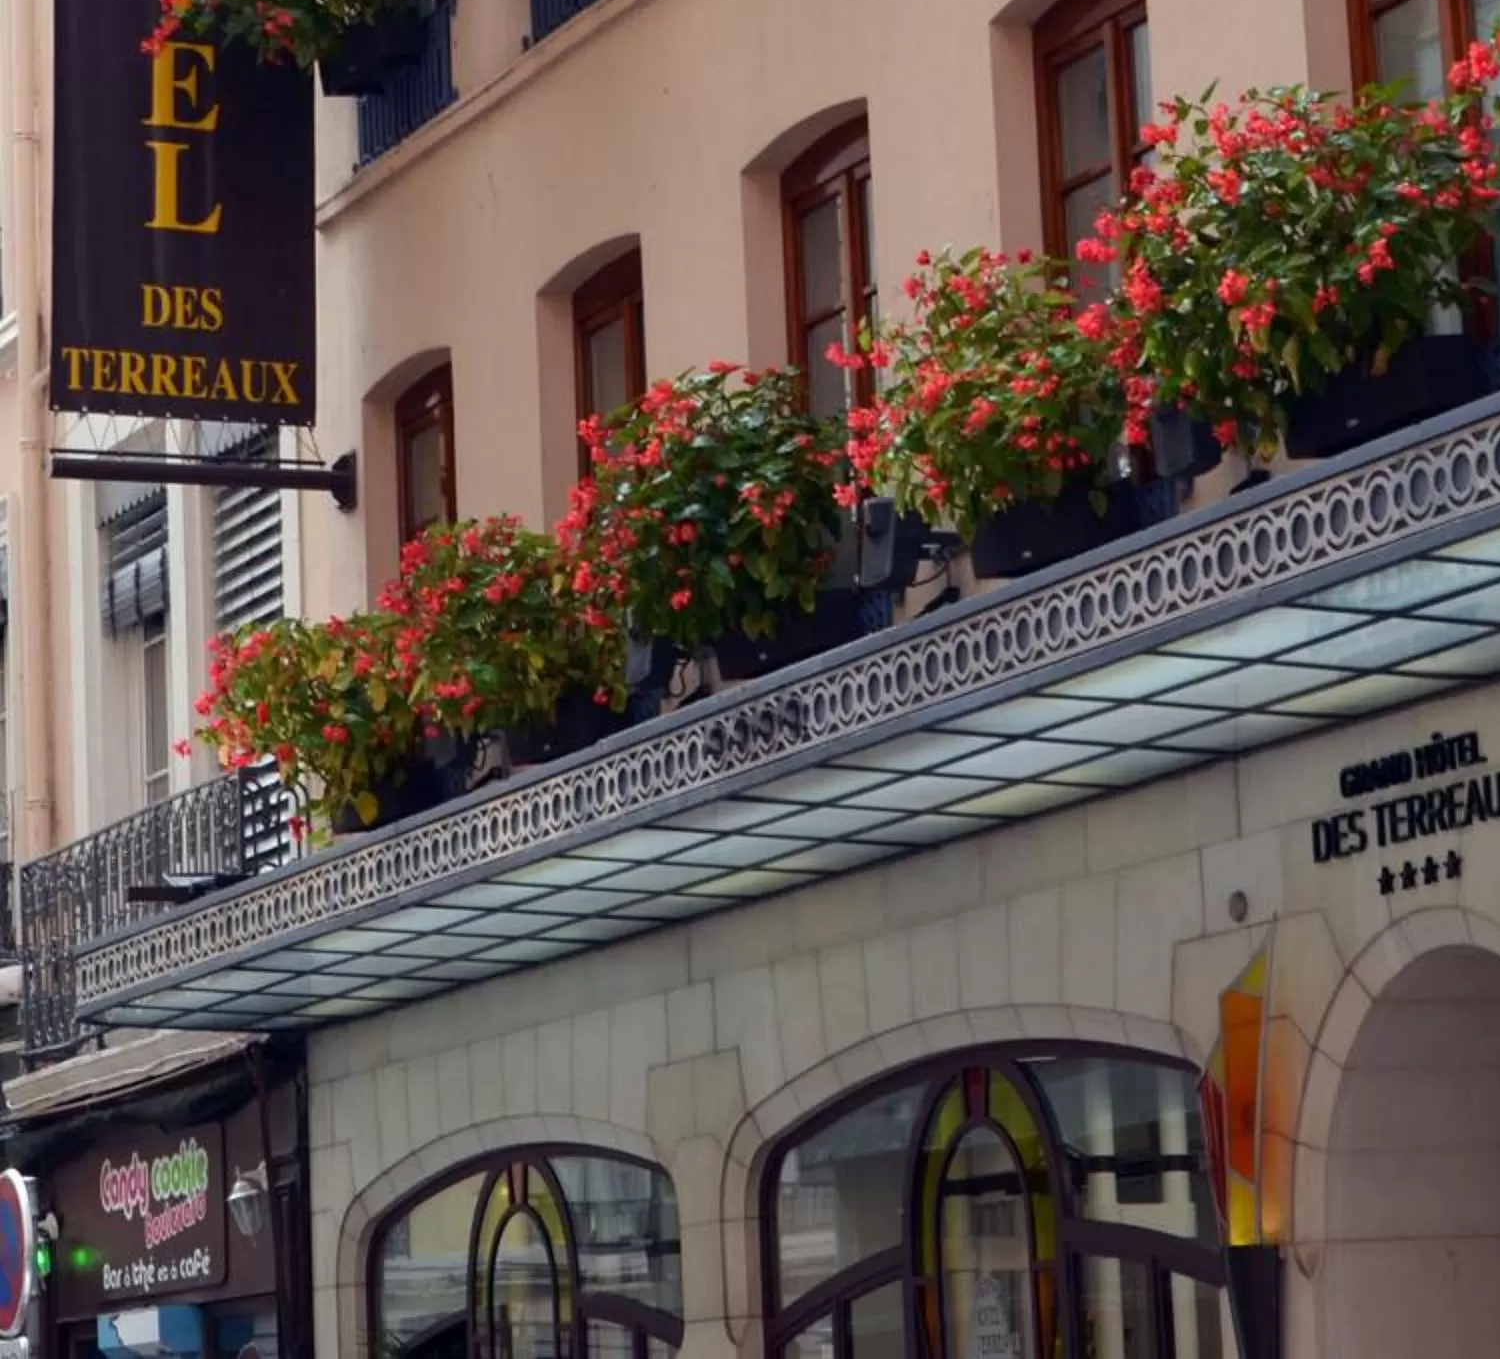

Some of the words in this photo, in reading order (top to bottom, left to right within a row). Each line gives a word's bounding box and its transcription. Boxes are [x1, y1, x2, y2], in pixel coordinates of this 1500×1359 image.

[140, 284, 224, 331] DES
[61, 346, 300, 404] TERREAUX
[1340, 749, 1413, 798] GRAND
[1312, 810, 1368, 863] DES
[103, 1263, 122, 1290] Bar
